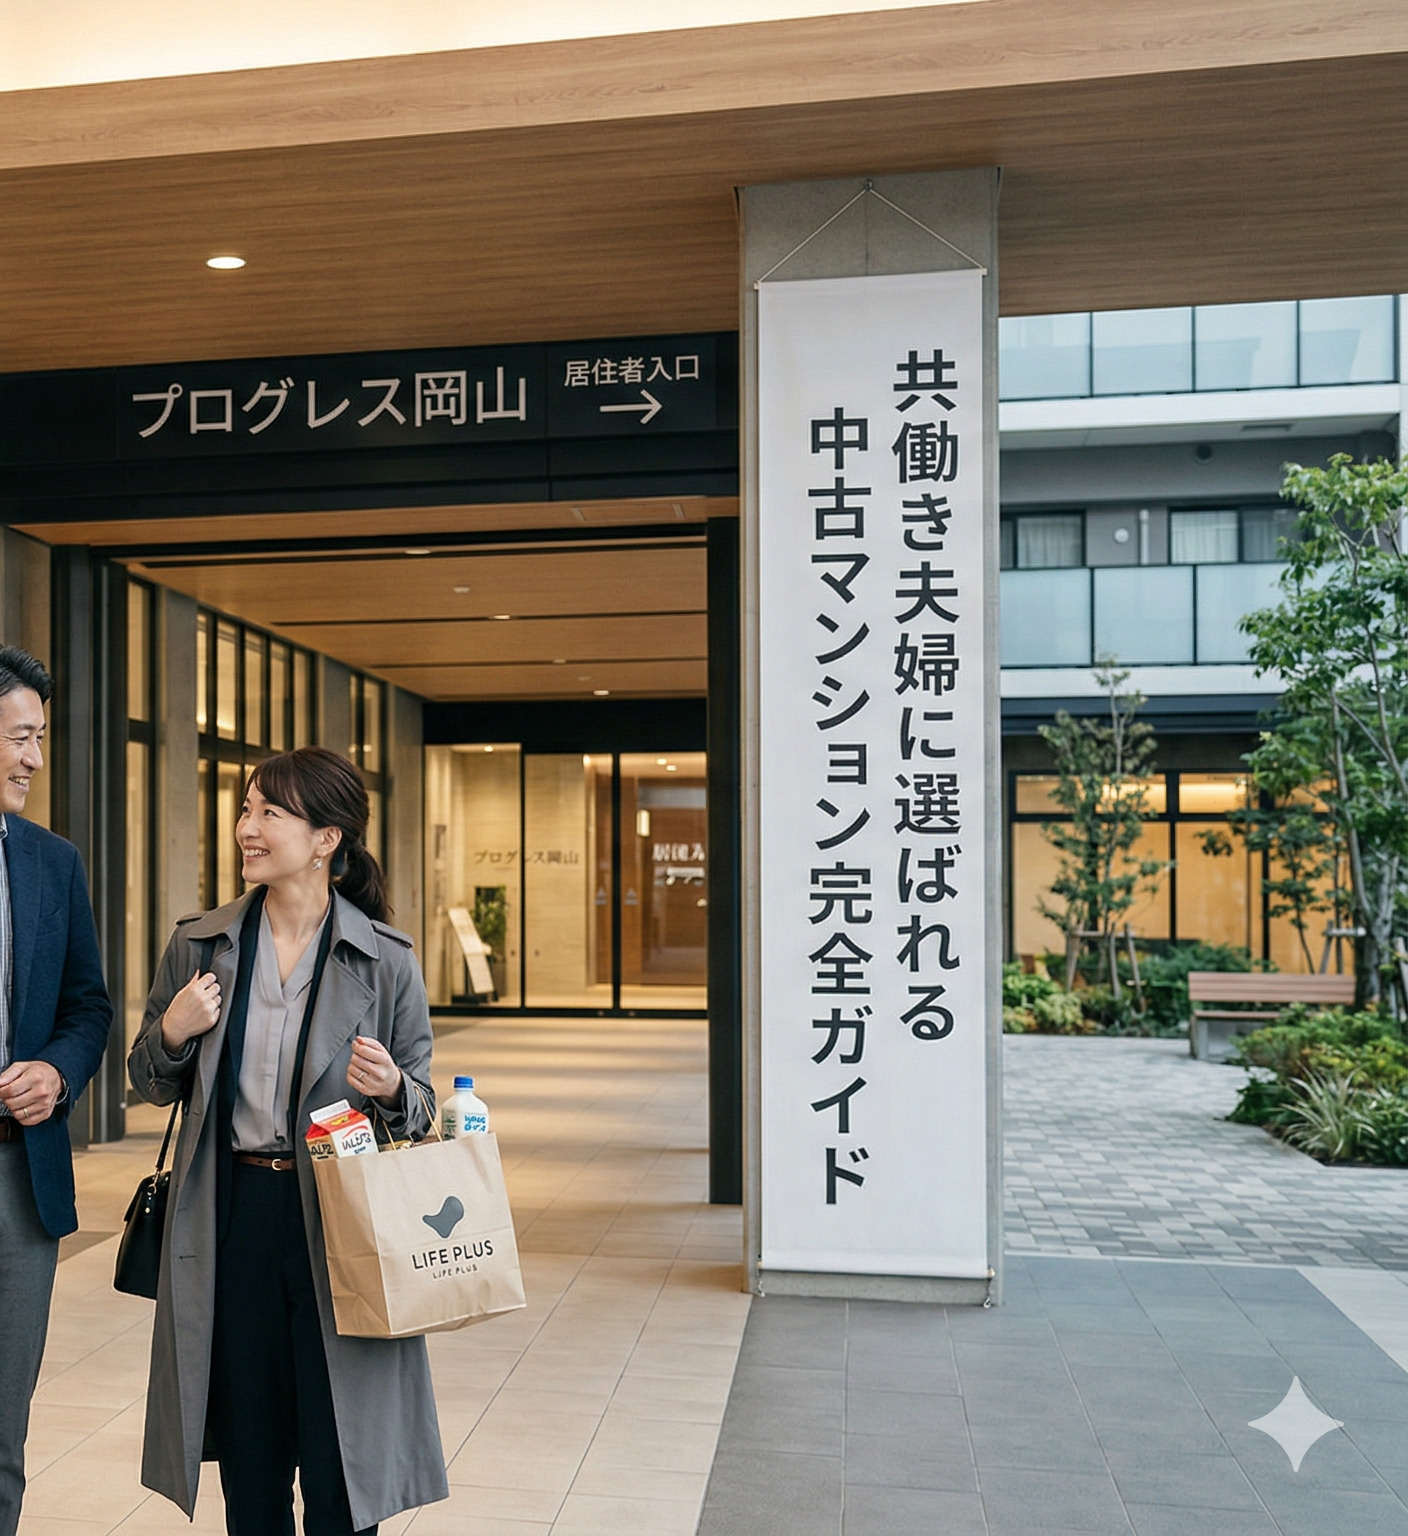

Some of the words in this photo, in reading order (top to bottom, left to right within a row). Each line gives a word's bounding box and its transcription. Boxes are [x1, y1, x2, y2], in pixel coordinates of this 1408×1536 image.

[132, 366, 527, 438] プログレス岡山
[564, 354, 700, 388] 居住者入口
[891, 348, 962, 1041] 共働き夫婦に選ばれる
[808, 406, 874, 1205] 中古マンション完全ガイド
[412, 1248, 449, 1270] LIFE
[453, 1239, 493, 1261] PLUS
